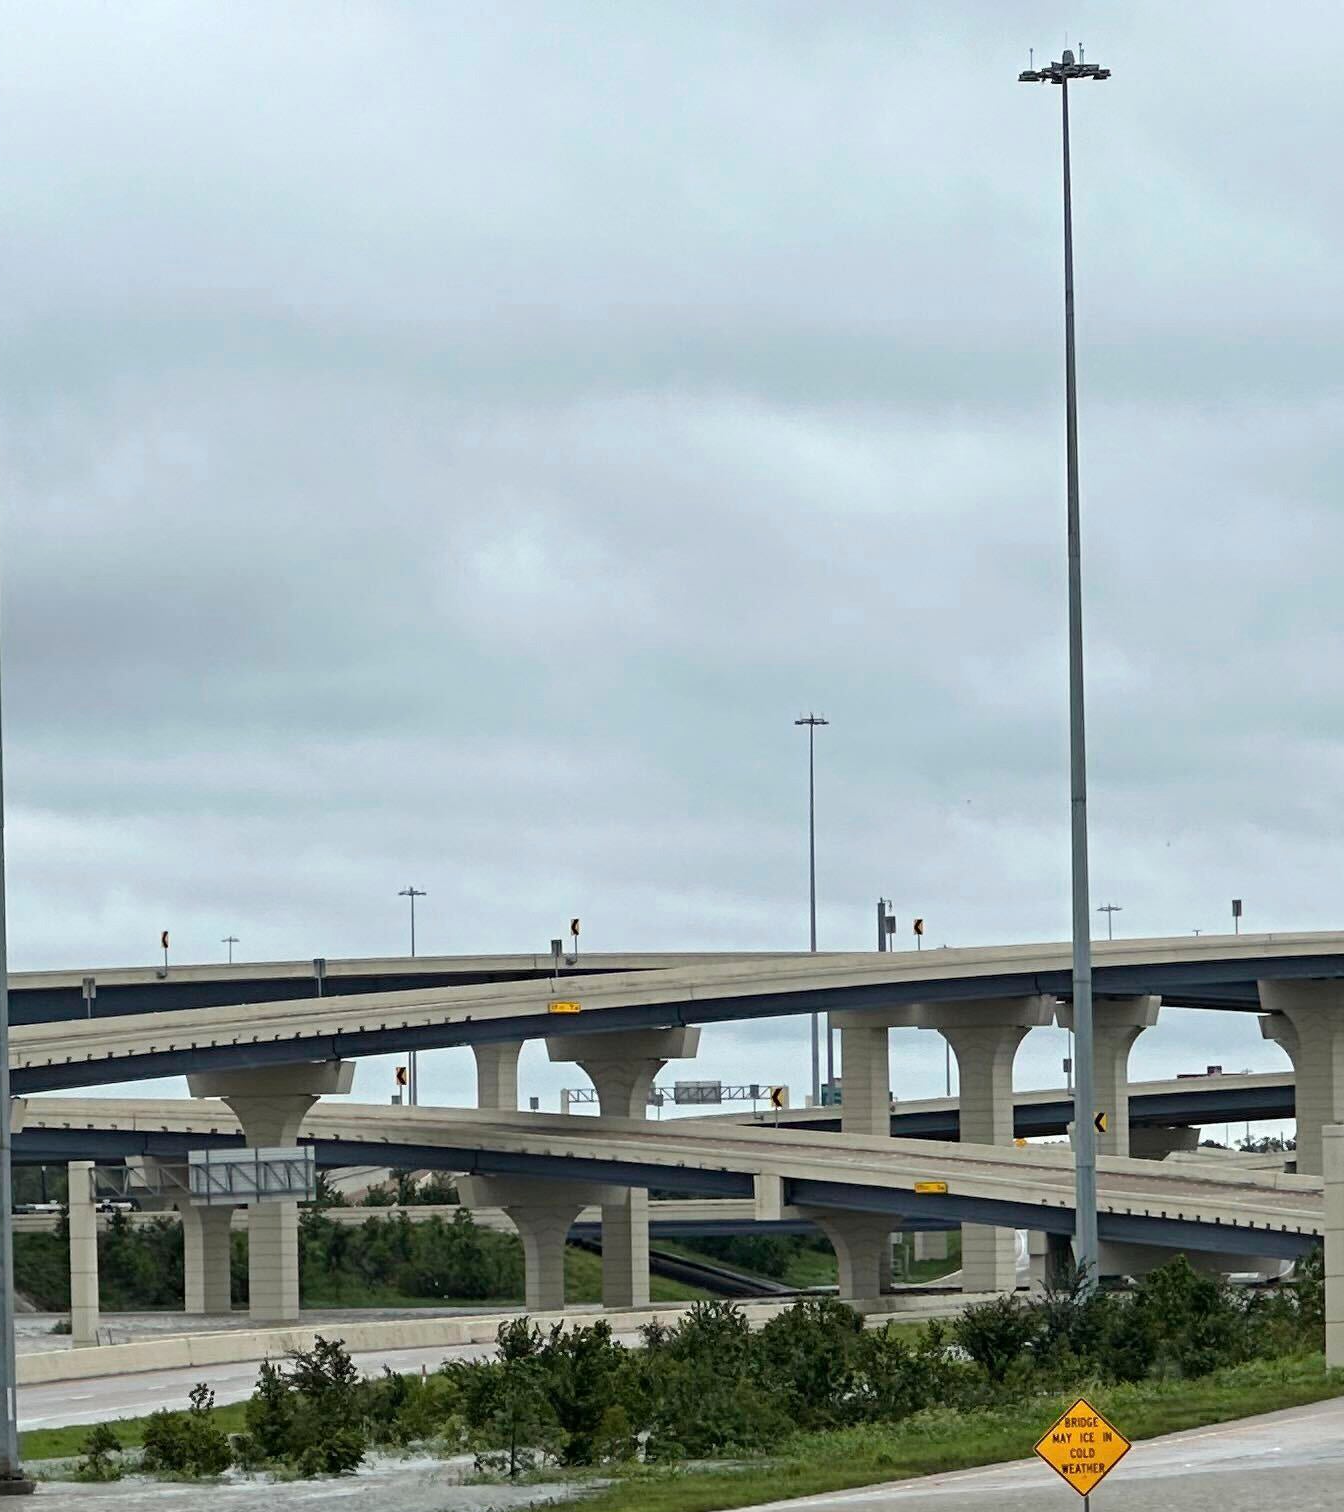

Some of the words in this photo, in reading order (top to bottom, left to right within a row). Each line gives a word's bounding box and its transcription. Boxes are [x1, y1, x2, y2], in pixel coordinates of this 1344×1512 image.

[1064, 1417, 1099, 1428] BRIDGE
[1052, 1432, 1072, 1443] MAY
[1080, 1432, 1094, 1442] ICE
[1102, 1432, 1112, 1442] IN
[1069, 1448, 1095, 1459] COLD
[1061, 1463, 1105, 1474] WEATHER
